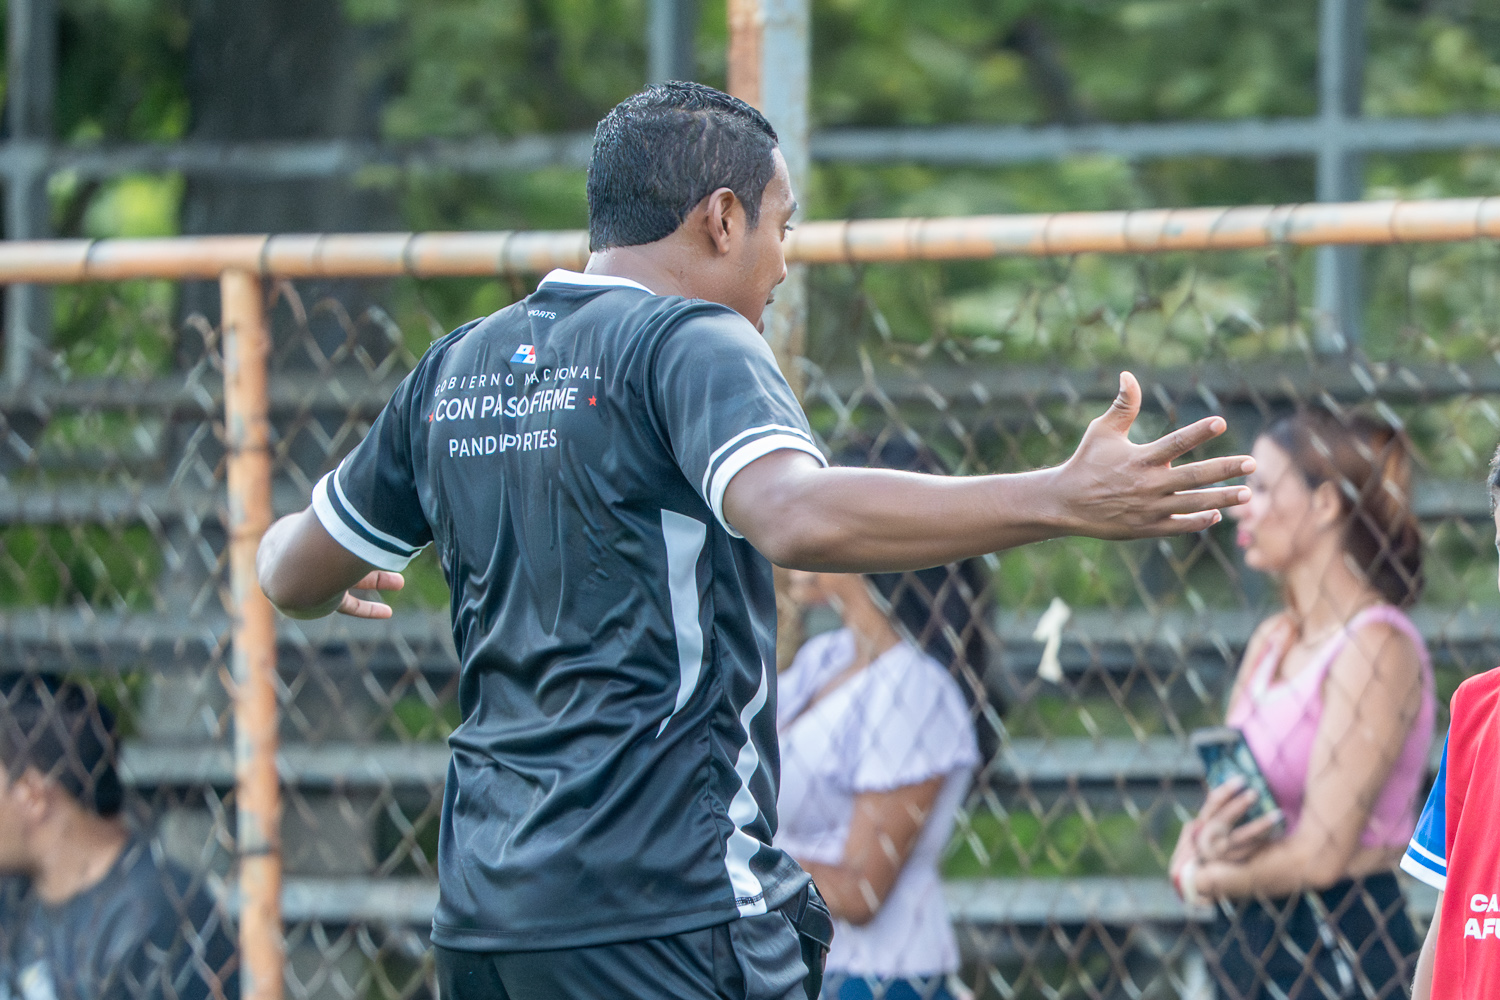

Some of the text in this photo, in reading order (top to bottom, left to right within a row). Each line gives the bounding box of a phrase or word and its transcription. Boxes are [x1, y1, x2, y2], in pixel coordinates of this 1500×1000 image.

[434, 366, 602, 397] GOBIERNO NACIONAL
[435, 387, 579, 422] CON PASO FIRME
